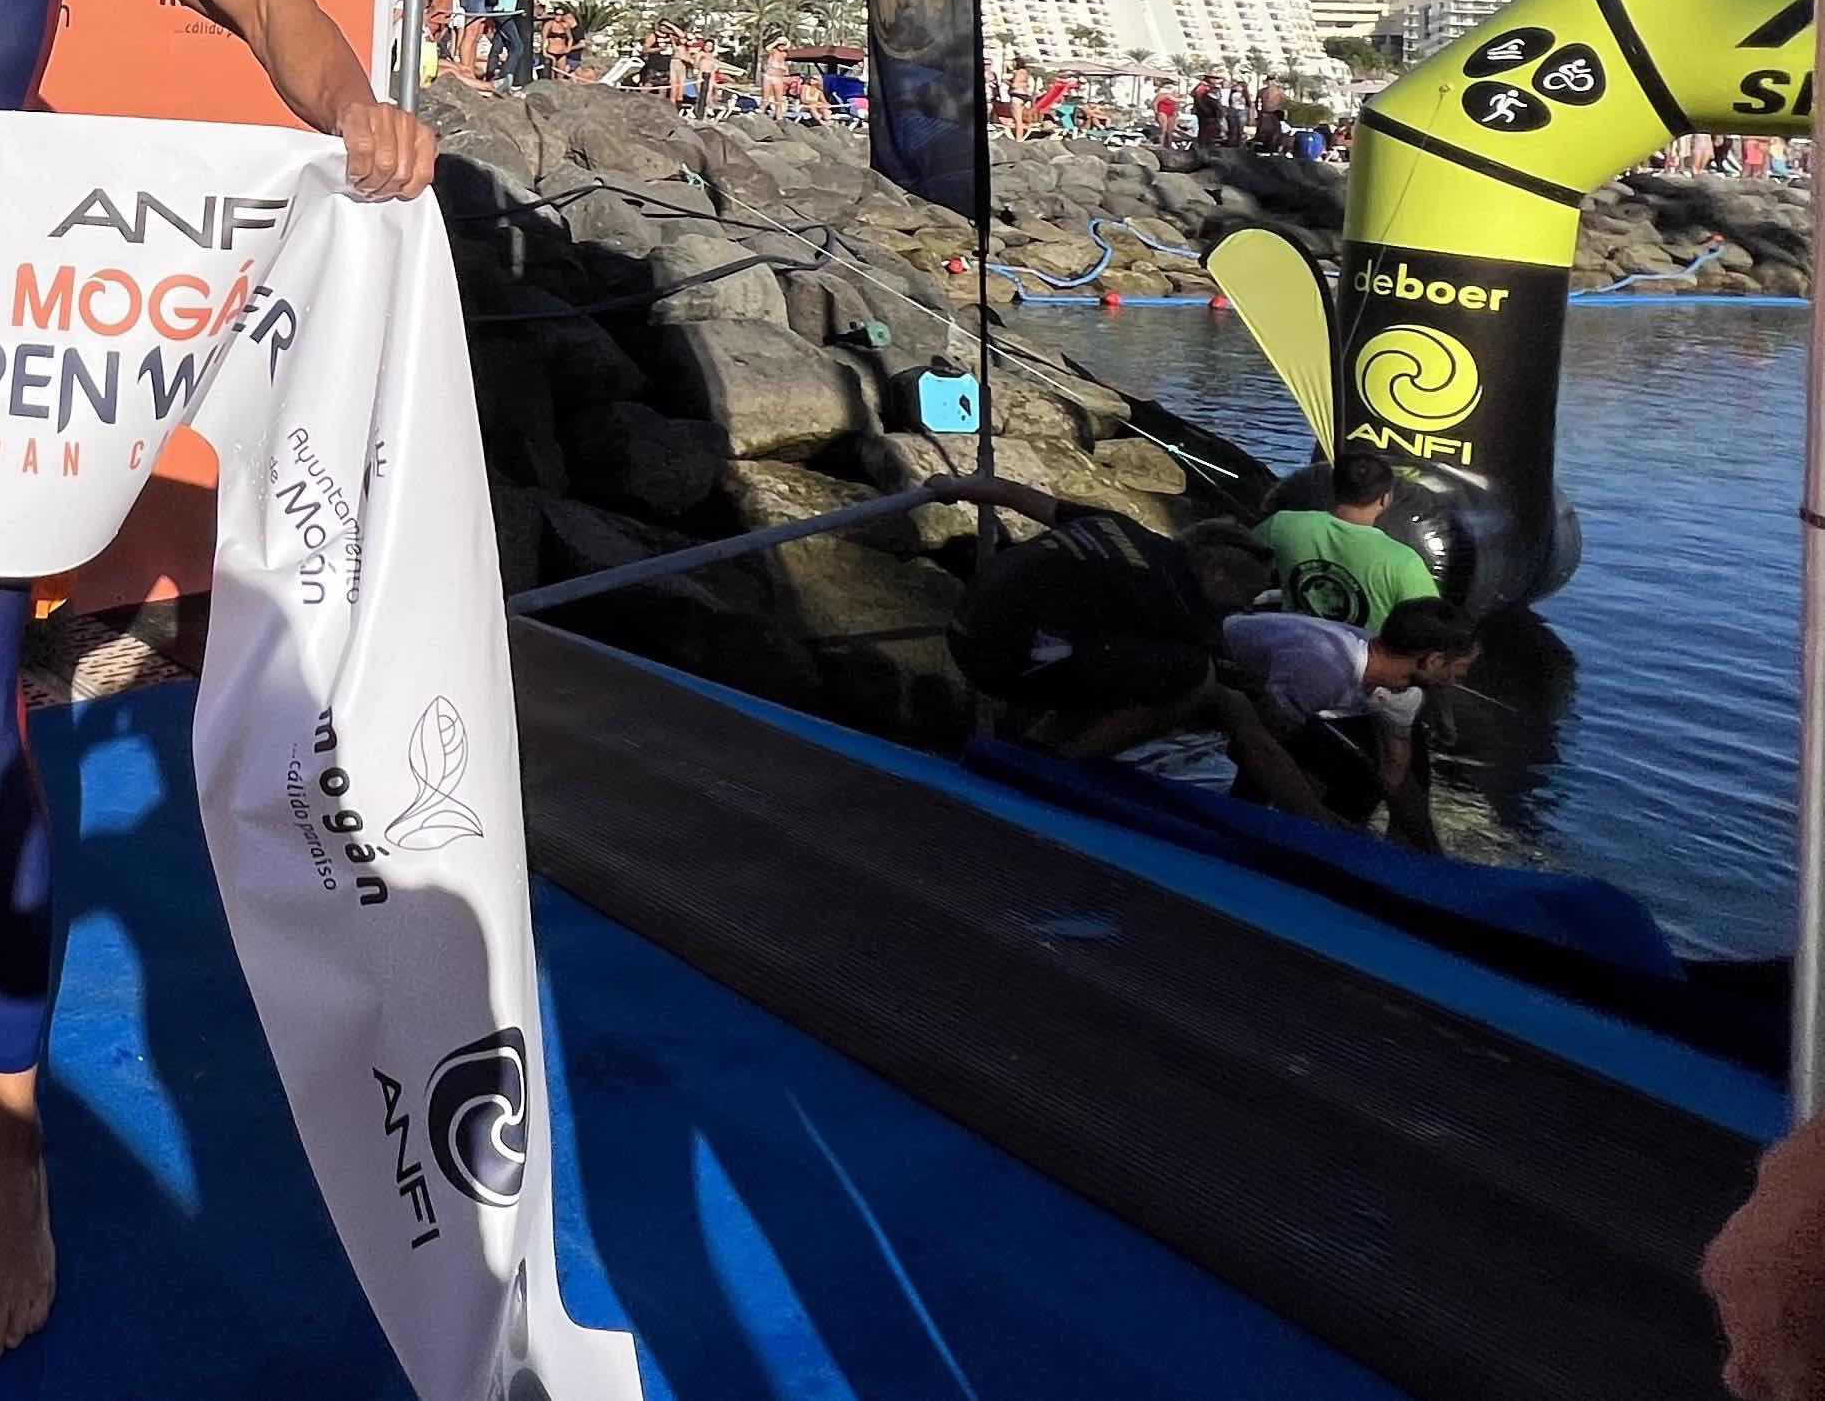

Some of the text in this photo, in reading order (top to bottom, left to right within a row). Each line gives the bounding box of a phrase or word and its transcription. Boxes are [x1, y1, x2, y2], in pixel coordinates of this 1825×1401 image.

[11, 259, 256, 341] MOGÁ
[1354, 259, 1509, 312] deboer
[1347, 423, 1473, 466] ANFI
[372, 1067, 441, 1250] ANFI
